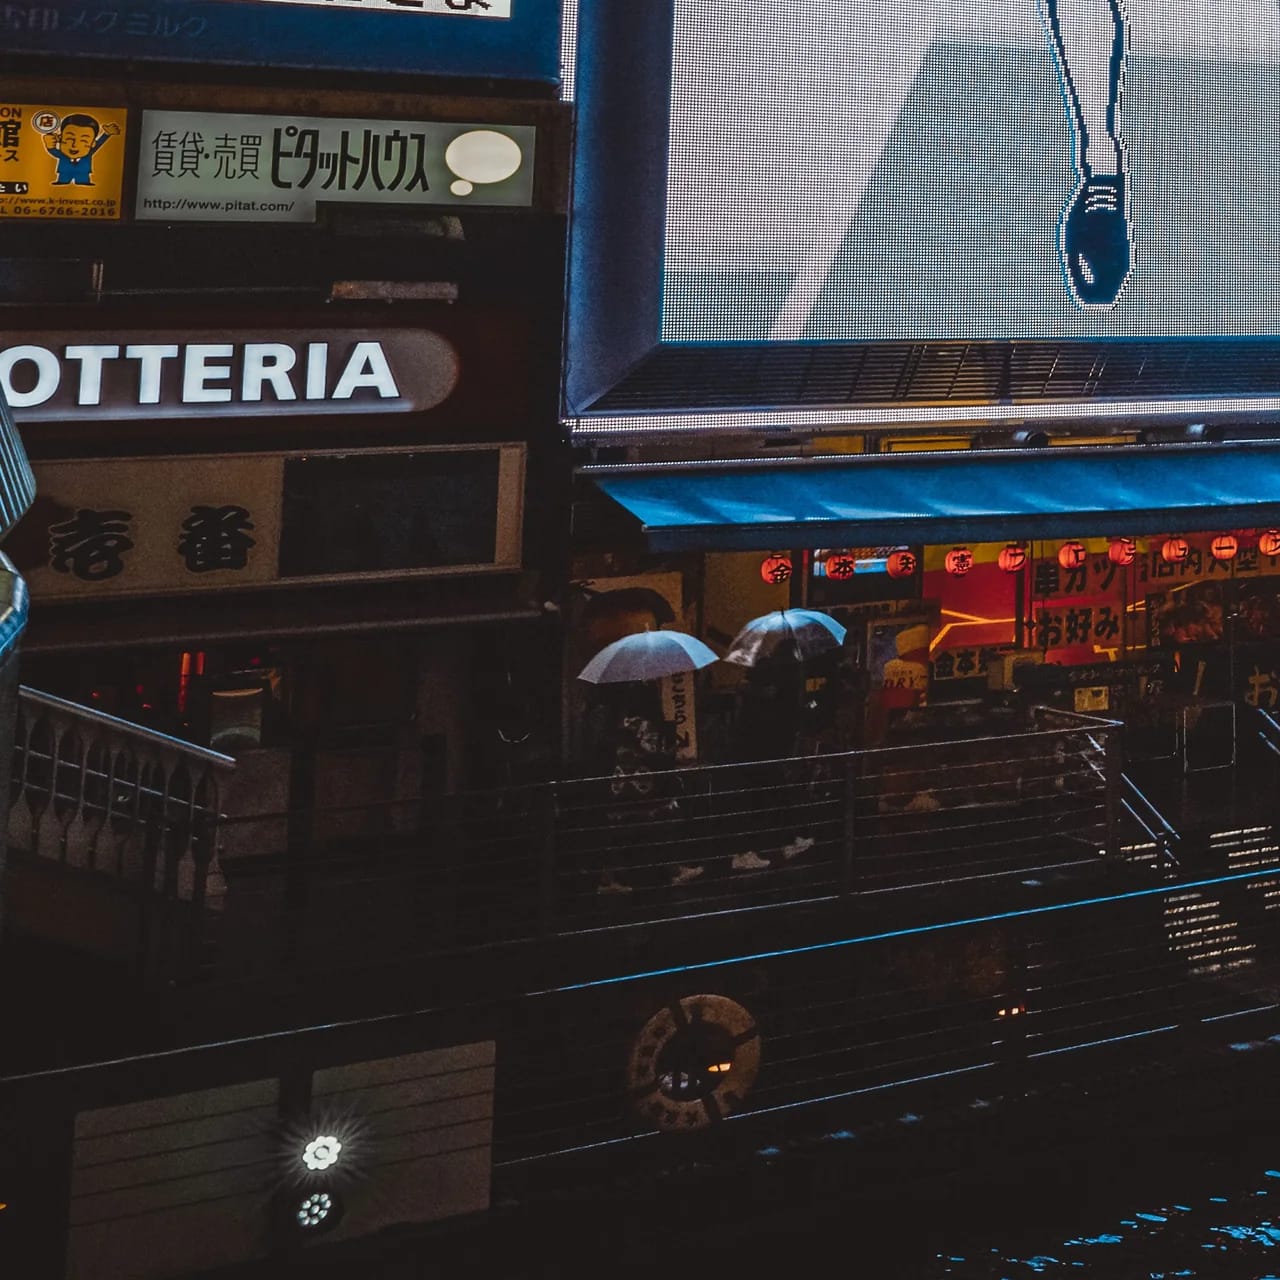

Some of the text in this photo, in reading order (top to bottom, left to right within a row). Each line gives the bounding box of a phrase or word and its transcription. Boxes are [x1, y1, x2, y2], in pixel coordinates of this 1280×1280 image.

[152, 126, 430, 192] 賃貸・売買 ピタットハウス
[143, 198, 295, 214] http://www.pitat.com/
